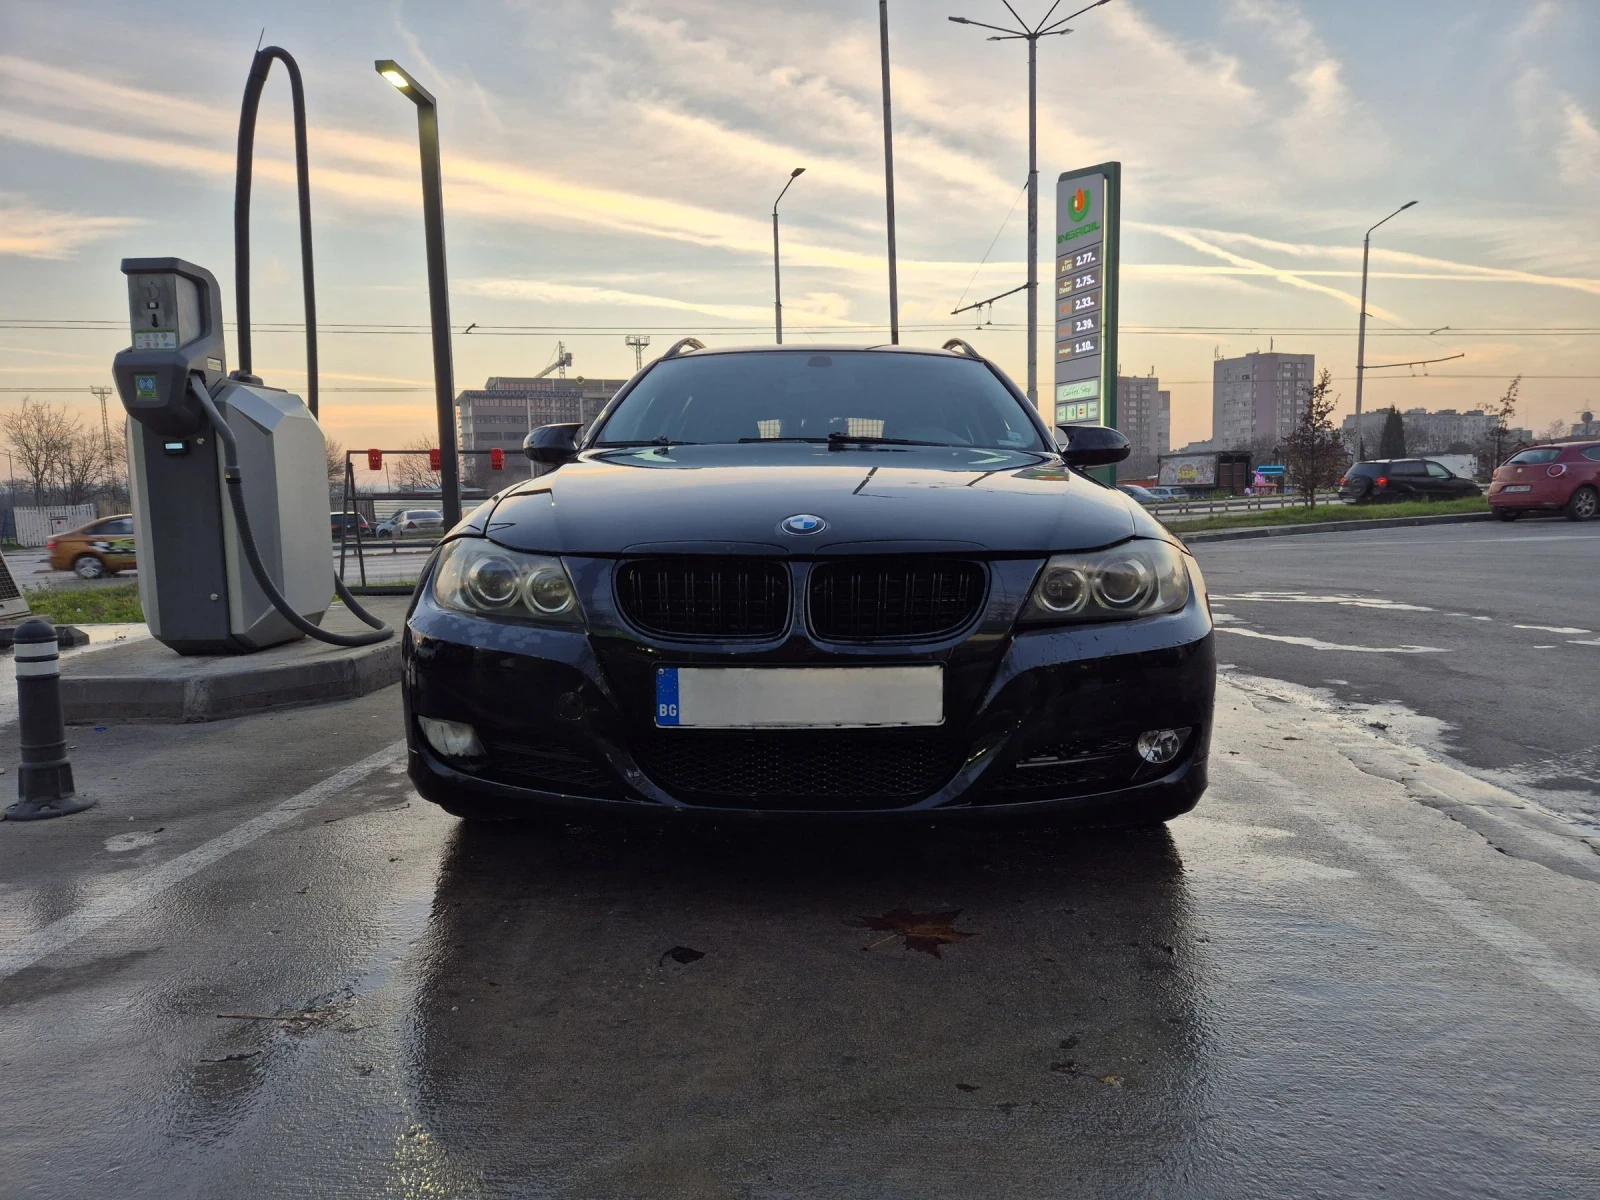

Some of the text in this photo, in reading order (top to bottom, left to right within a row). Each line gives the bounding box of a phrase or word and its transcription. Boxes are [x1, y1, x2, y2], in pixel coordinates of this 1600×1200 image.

[1062, 384, 1092, 398] Coffee Shop
[659, 704, 677, 717] BG
